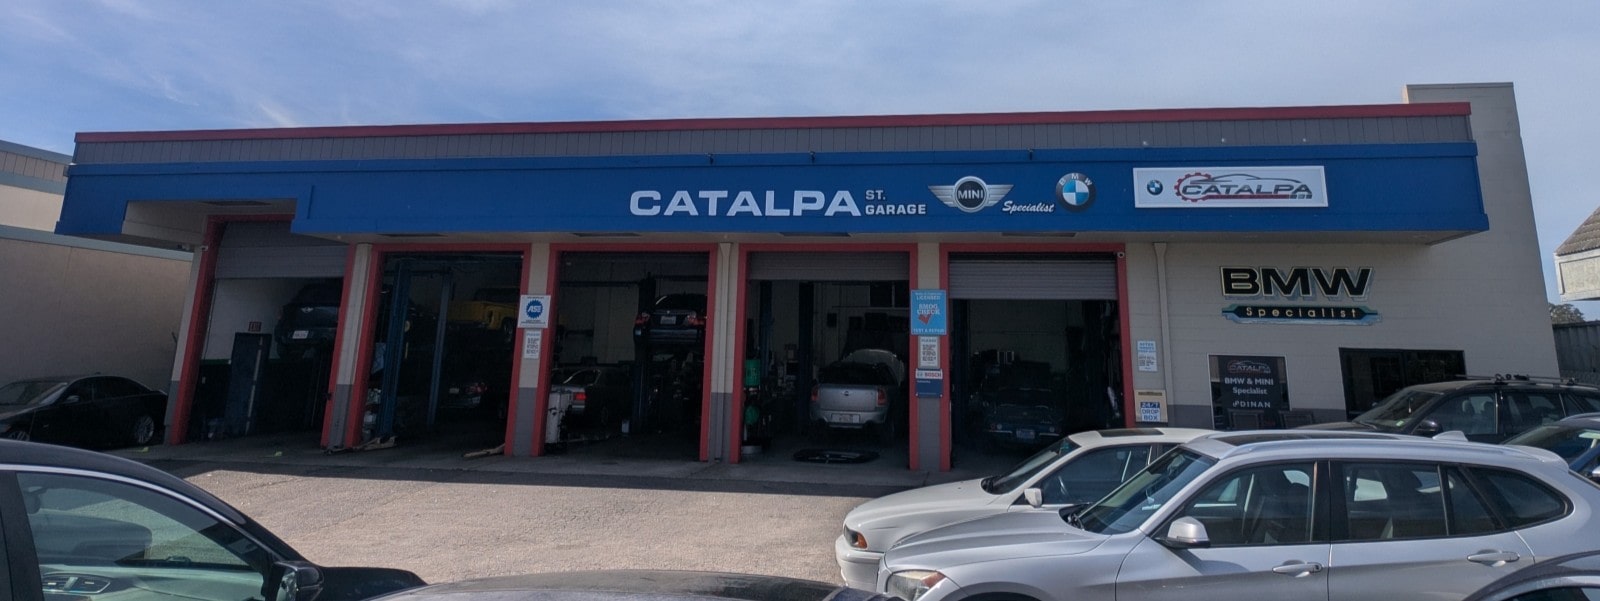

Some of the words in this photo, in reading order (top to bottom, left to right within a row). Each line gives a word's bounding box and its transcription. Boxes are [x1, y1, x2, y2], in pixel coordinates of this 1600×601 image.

[1059, 173, 1093, 186] BMW
[865, 190, 886, 200] ST.
[957, 189, 984, 200] MINI
[1182, 184, 1312, 195] CATALPA
[629, 190, 861, 217] CATALPA
[865, 203, 926, 216] GARAGE
[1002, 199, 1055, 215] Specialist
[1220, 266, 1374, 297] BMW
[1246, 306, 1357, 319] Specialist
[1224, 377, 1245, 385] BMW
[1246, 377, 1253, 385] &
[1254, 378, 1274, 386] MINI
[1232, 387, 1268, 396] Specialist
